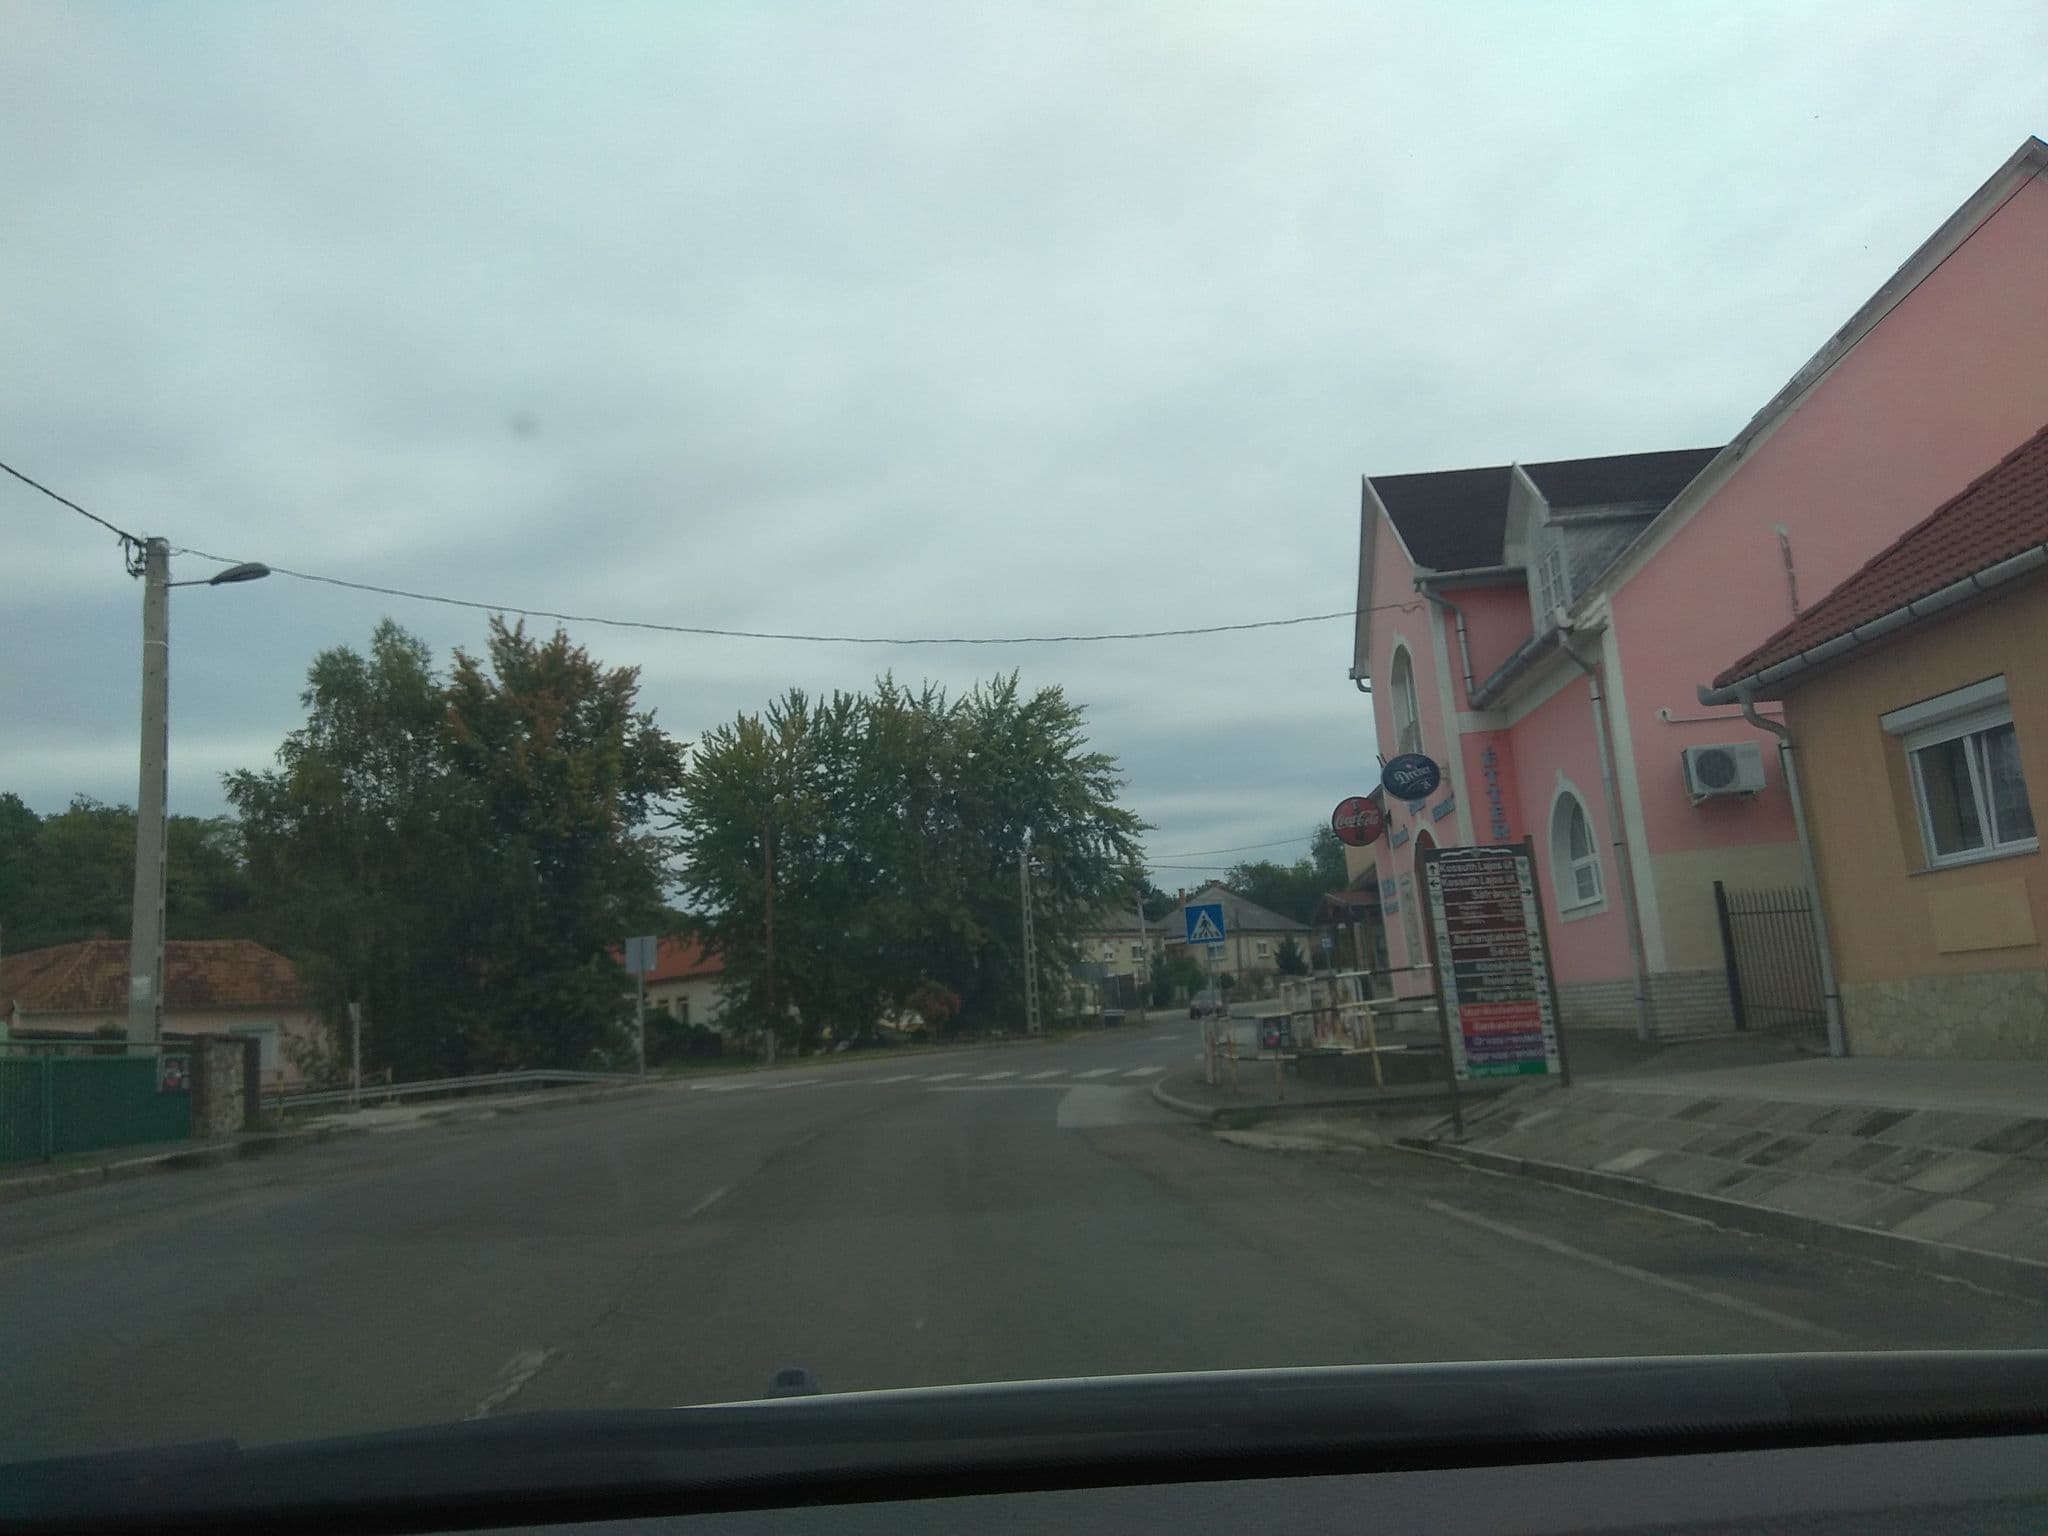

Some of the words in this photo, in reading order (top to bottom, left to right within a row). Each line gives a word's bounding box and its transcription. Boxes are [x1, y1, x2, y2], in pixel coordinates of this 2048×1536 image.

[1440, 862, 1477, 873] Kossuth
[1478, 860, 1503, 873] Lajos
[1441, 876, 1479, 887] Kossuth
[1480, 875, 1504, 888] Lajos
